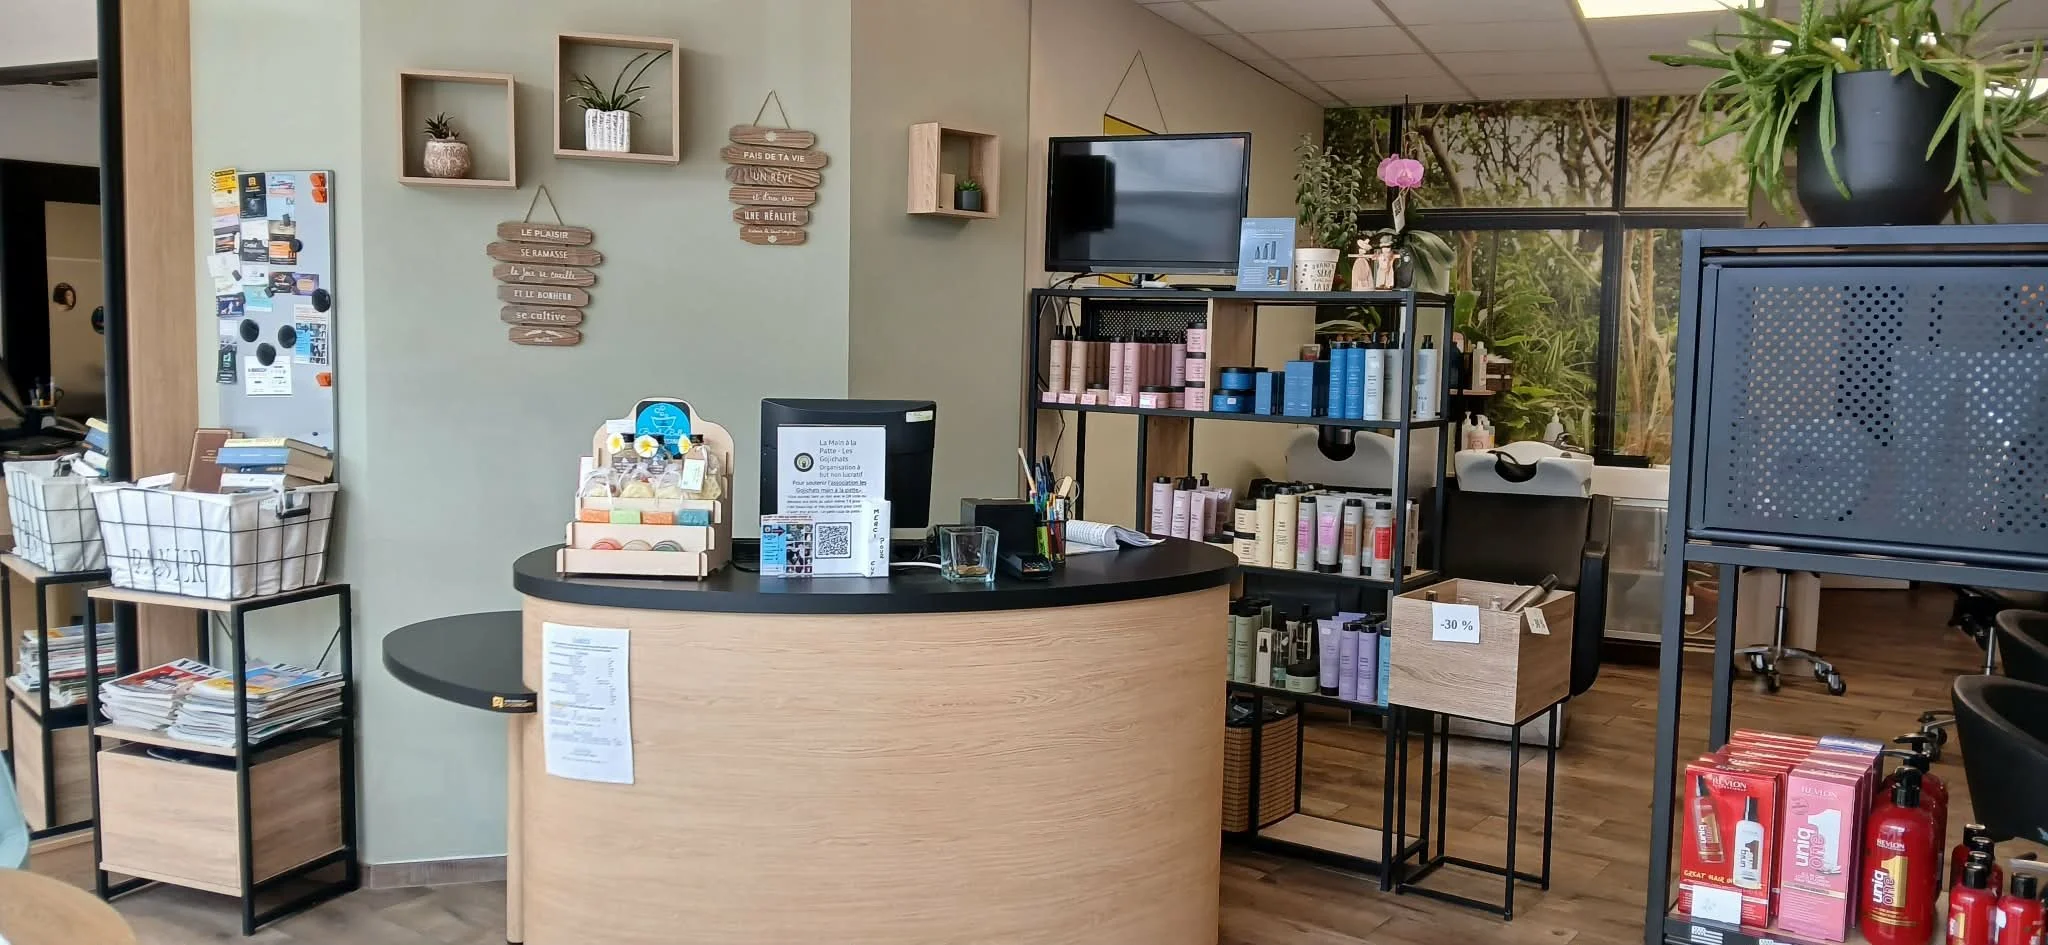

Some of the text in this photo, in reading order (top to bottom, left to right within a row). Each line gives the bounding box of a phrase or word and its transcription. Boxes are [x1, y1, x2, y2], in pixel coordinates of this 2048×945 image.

[743, 151, 805, 163] FAIS DE TA VIE
[753, 171, 792, 183] UN RÊVE
[744, 210, 797, 222] UNE RÉALITÉ
[534, 230, 569, 239] PLAISIR
[520, 248, 568, 259] SE RAMASSE
[526, 290, 534, 298] LE
[538, 292, 572, 301] BONHEUR
[530, 310, 567, 321] cultive
[1440, 619, 1474, 631] -30 %
[1712, 776, 1747, 788] REVLON
[1801, 785, 1839, 798] REVLON
[1794, 826, 1816, 867] uniq
[1876, 839, 1905, 848] REVLON
[1810, 834, 1826, 870] one
[1684, 870, 1706, 878] GREAT
[1708, 874, 1725, 884] HAIR
[1872, 870, 1888, 904] uniq
[1883, 876, 1895, 906] one
